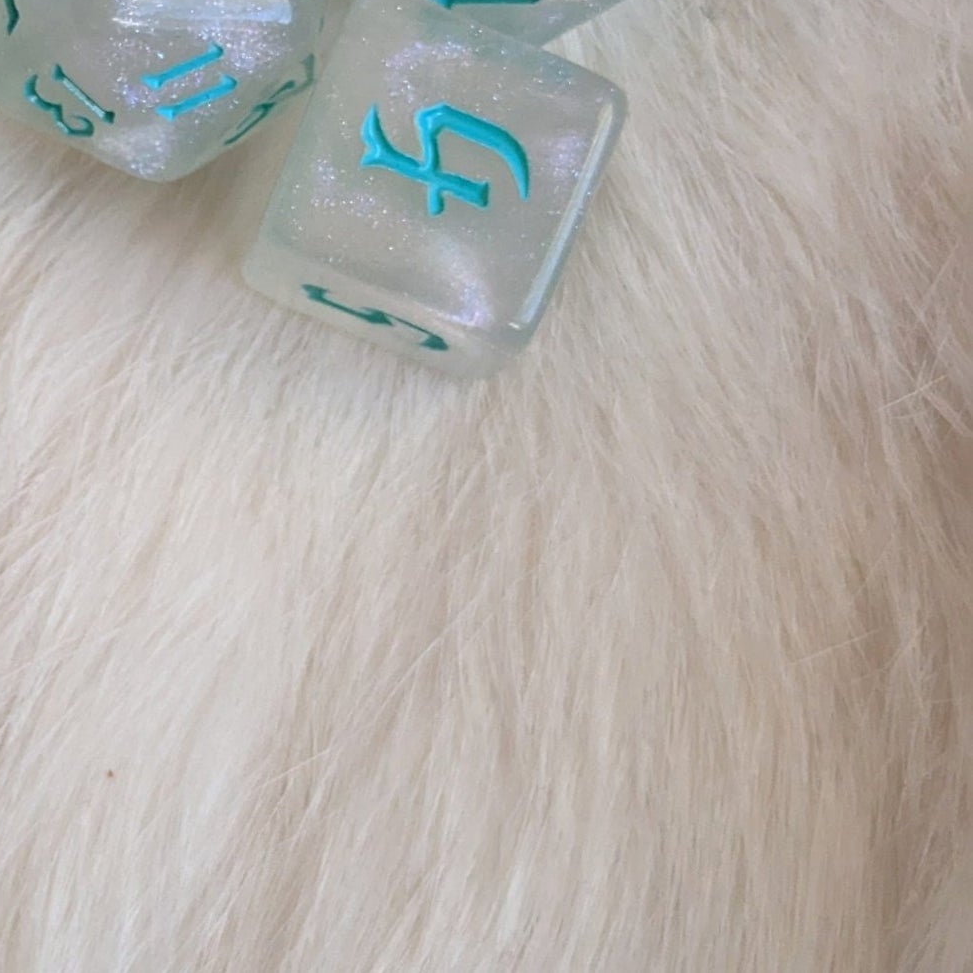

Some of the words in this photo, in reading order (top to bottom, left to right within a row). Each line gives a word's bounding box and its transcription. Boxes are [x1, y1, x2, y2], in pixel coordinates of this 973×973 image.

[22, 62, 117, 138] 13
[140, 42, 240, 123] 11
[359, 99, 532, 218] 4
